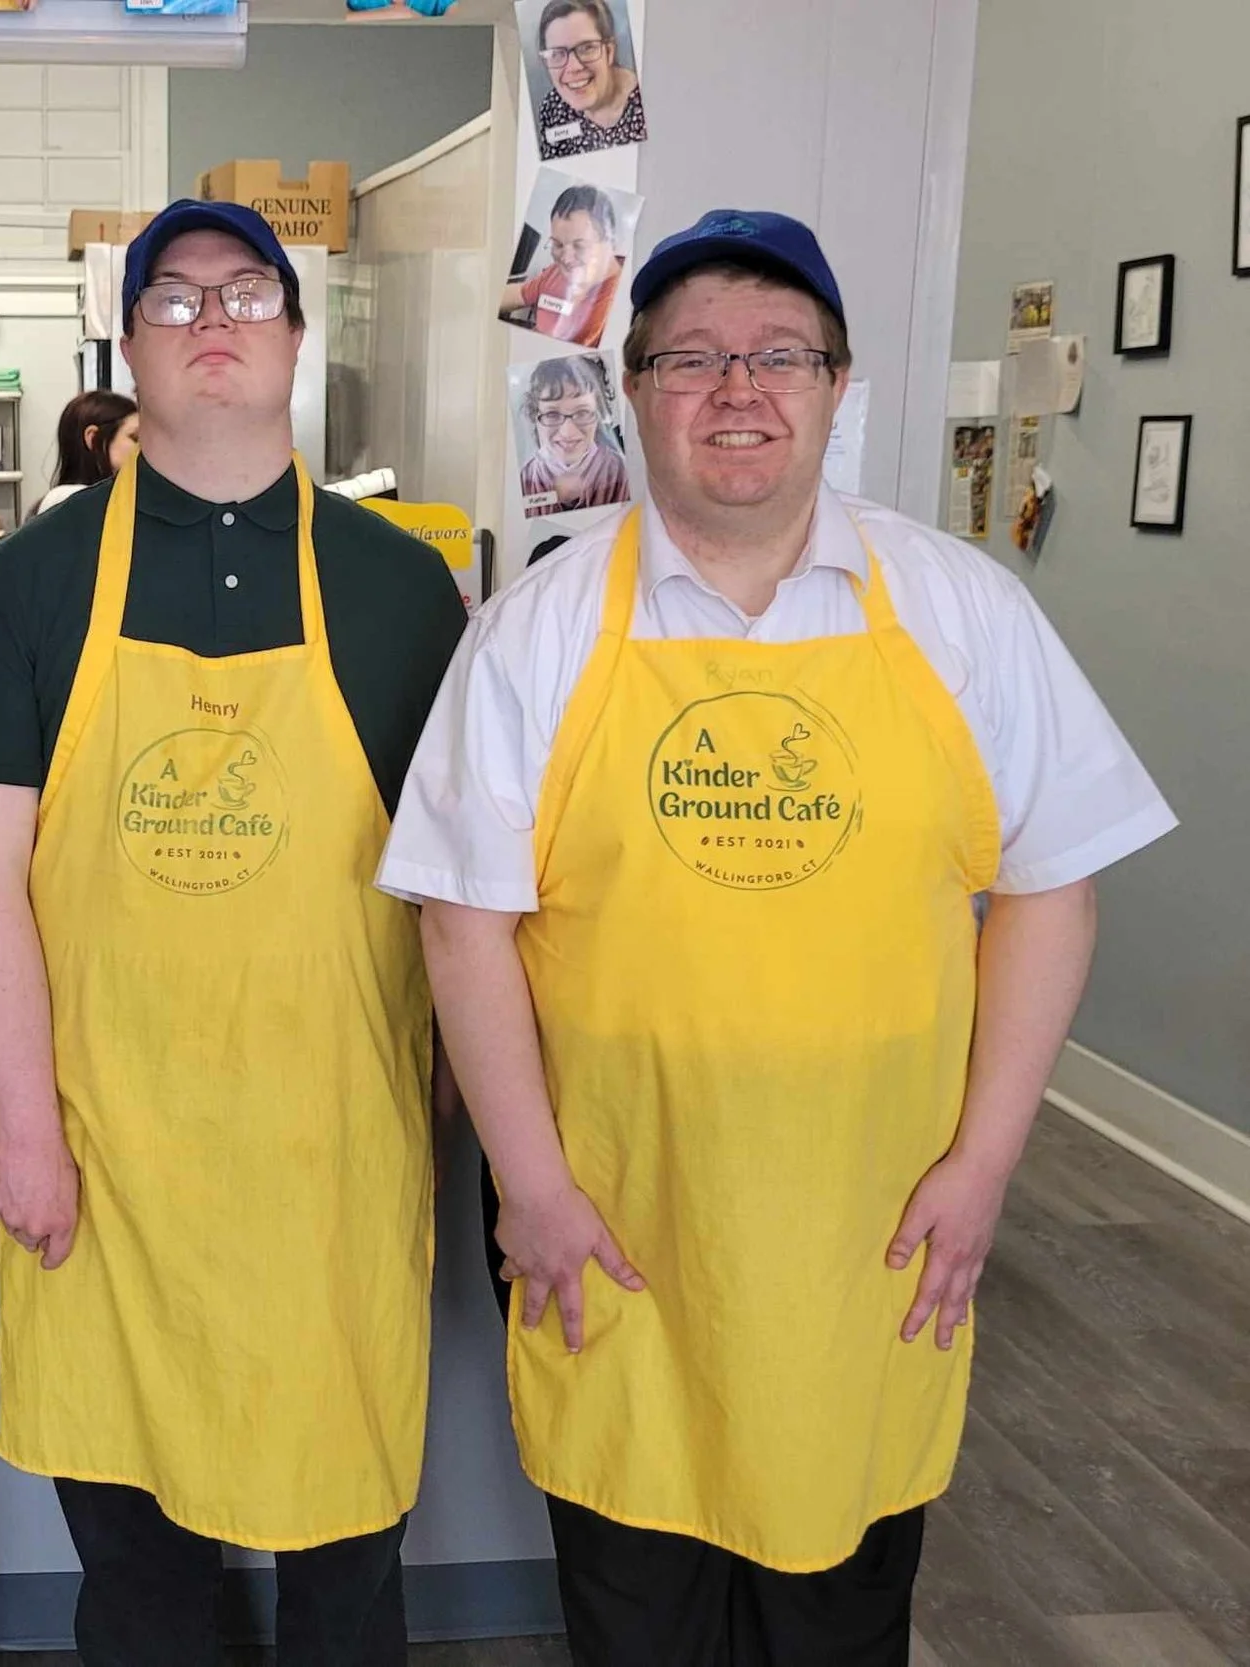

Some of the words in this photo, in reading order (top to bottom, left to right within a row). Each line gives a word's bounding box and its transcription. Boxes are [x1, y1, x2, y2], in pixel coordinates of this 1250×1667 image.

[251, 198, 331, 215] GENUINE
[271, 220, 320, 236] DAHO
[705, 660, 773, 689] Ryan
[191, 694, 239, 719] Henry
[694, 728, 716, 754] A
[160, 758, 178, 781] A
[663, 759, 760, 788] Kinder
[130, 782, 208, 810] Kinder
[659, 792, 771, 821] Ground
[778, 793, 841, 821] Café
[124, 810, 214, 835] Ground
[219, 814, 273, 837] Café
[167, 848, 192, 859] EST
[199, 850, 228, 860] 2021
[716, 836, 746, 847] EST
[755, 838, 790, 849] 2021
[237, 868, 250, 880] CT
[802, 859, 817, 873] CT
